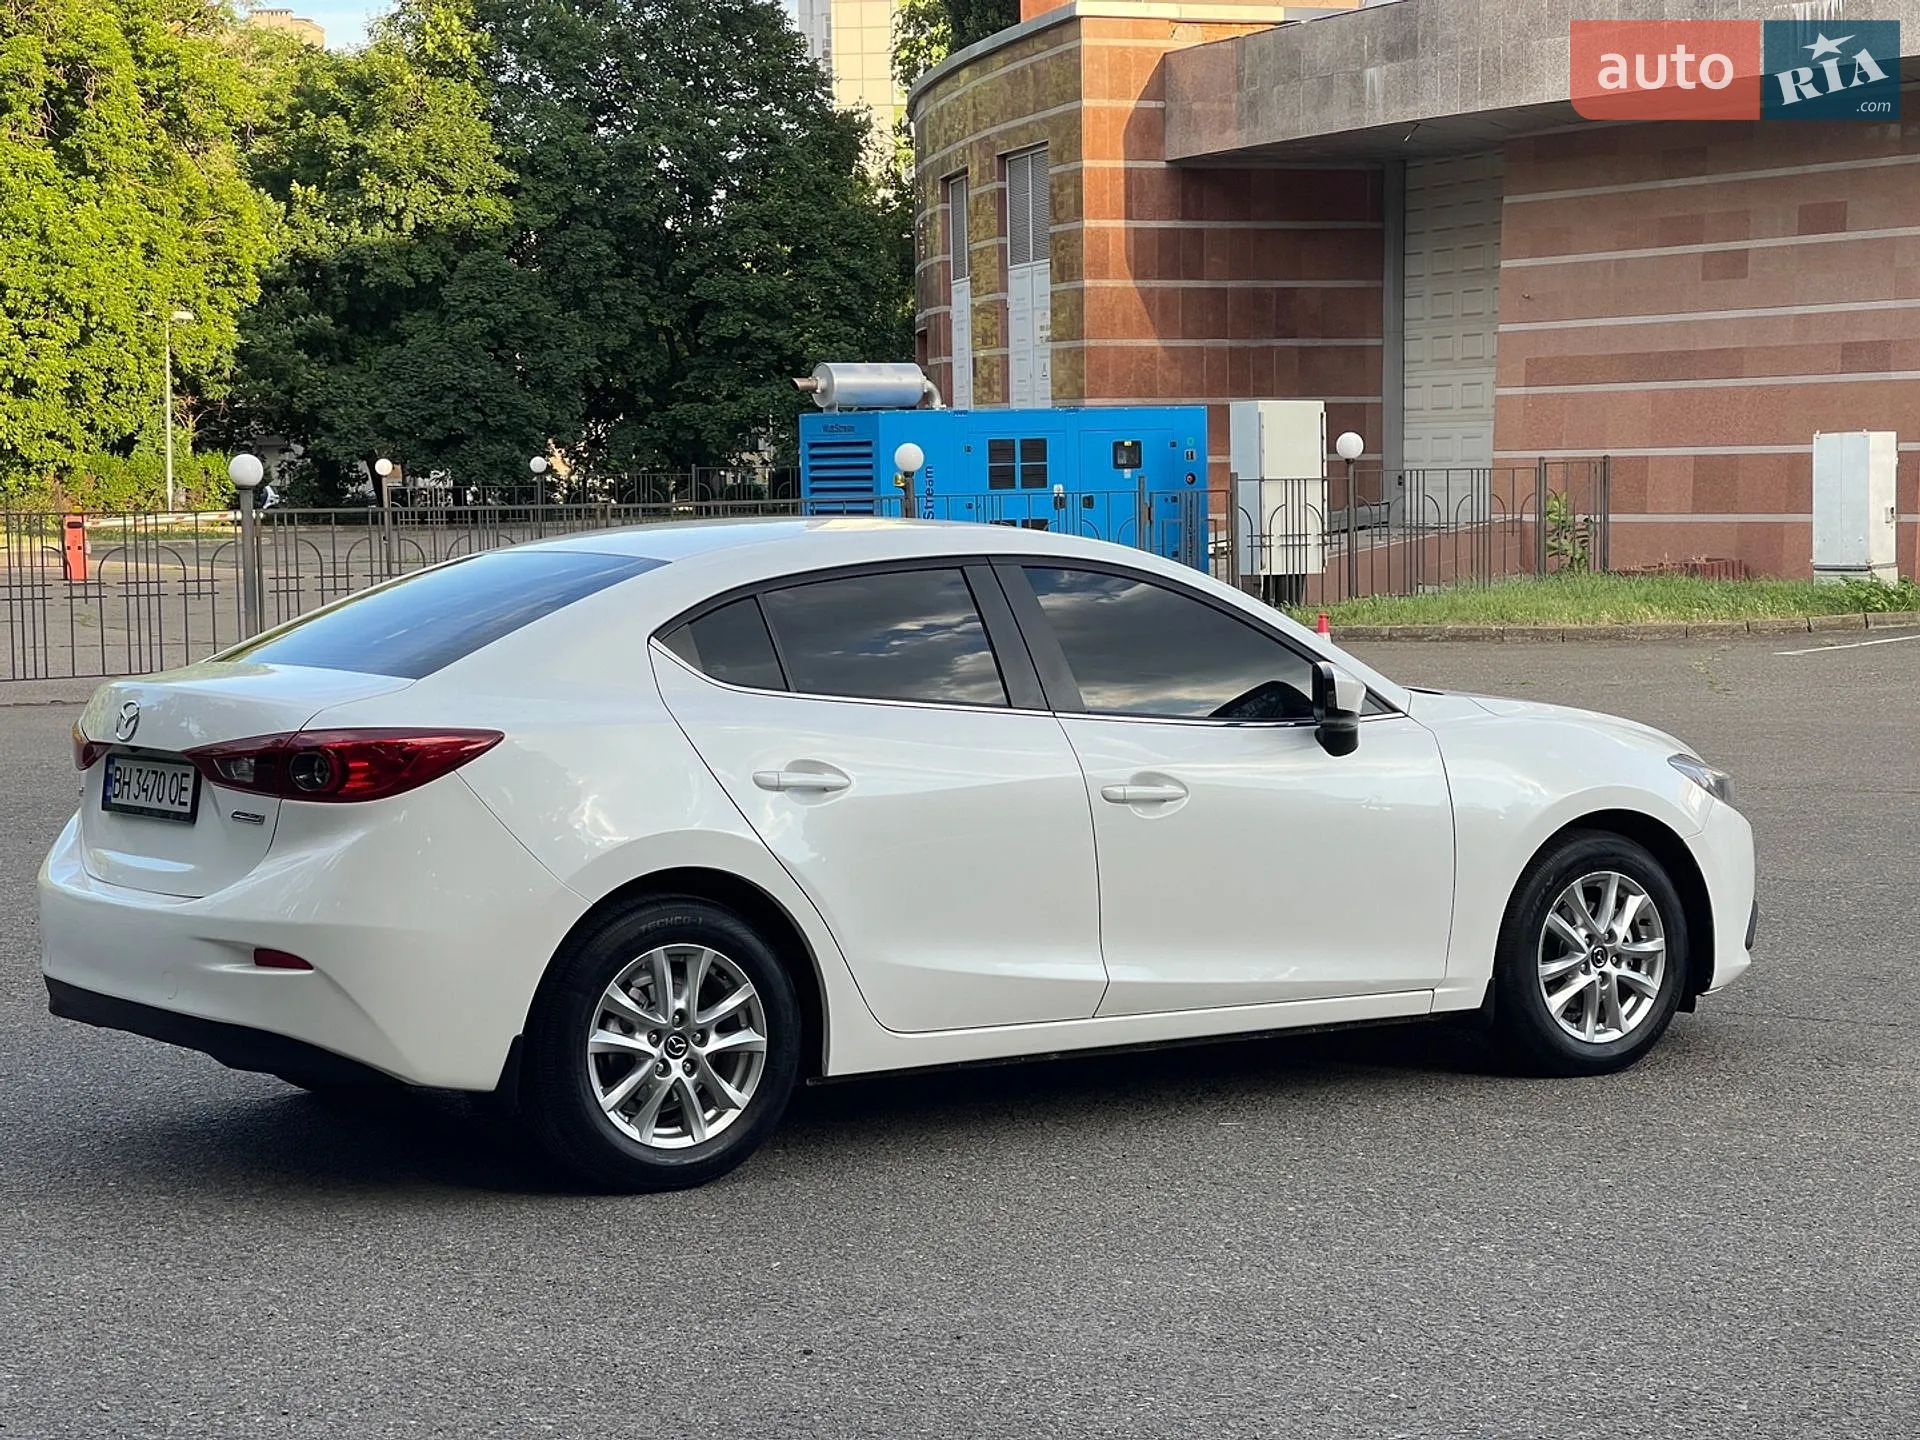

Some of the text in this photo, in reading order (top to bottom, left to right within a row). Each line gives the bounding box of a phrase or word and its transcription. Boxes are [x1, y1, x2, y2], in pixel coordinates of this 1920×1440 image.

[112, 766, 132, 800] BH
[133, 768, 166, 804] 3470
[169, 772, 190, 806] OE
